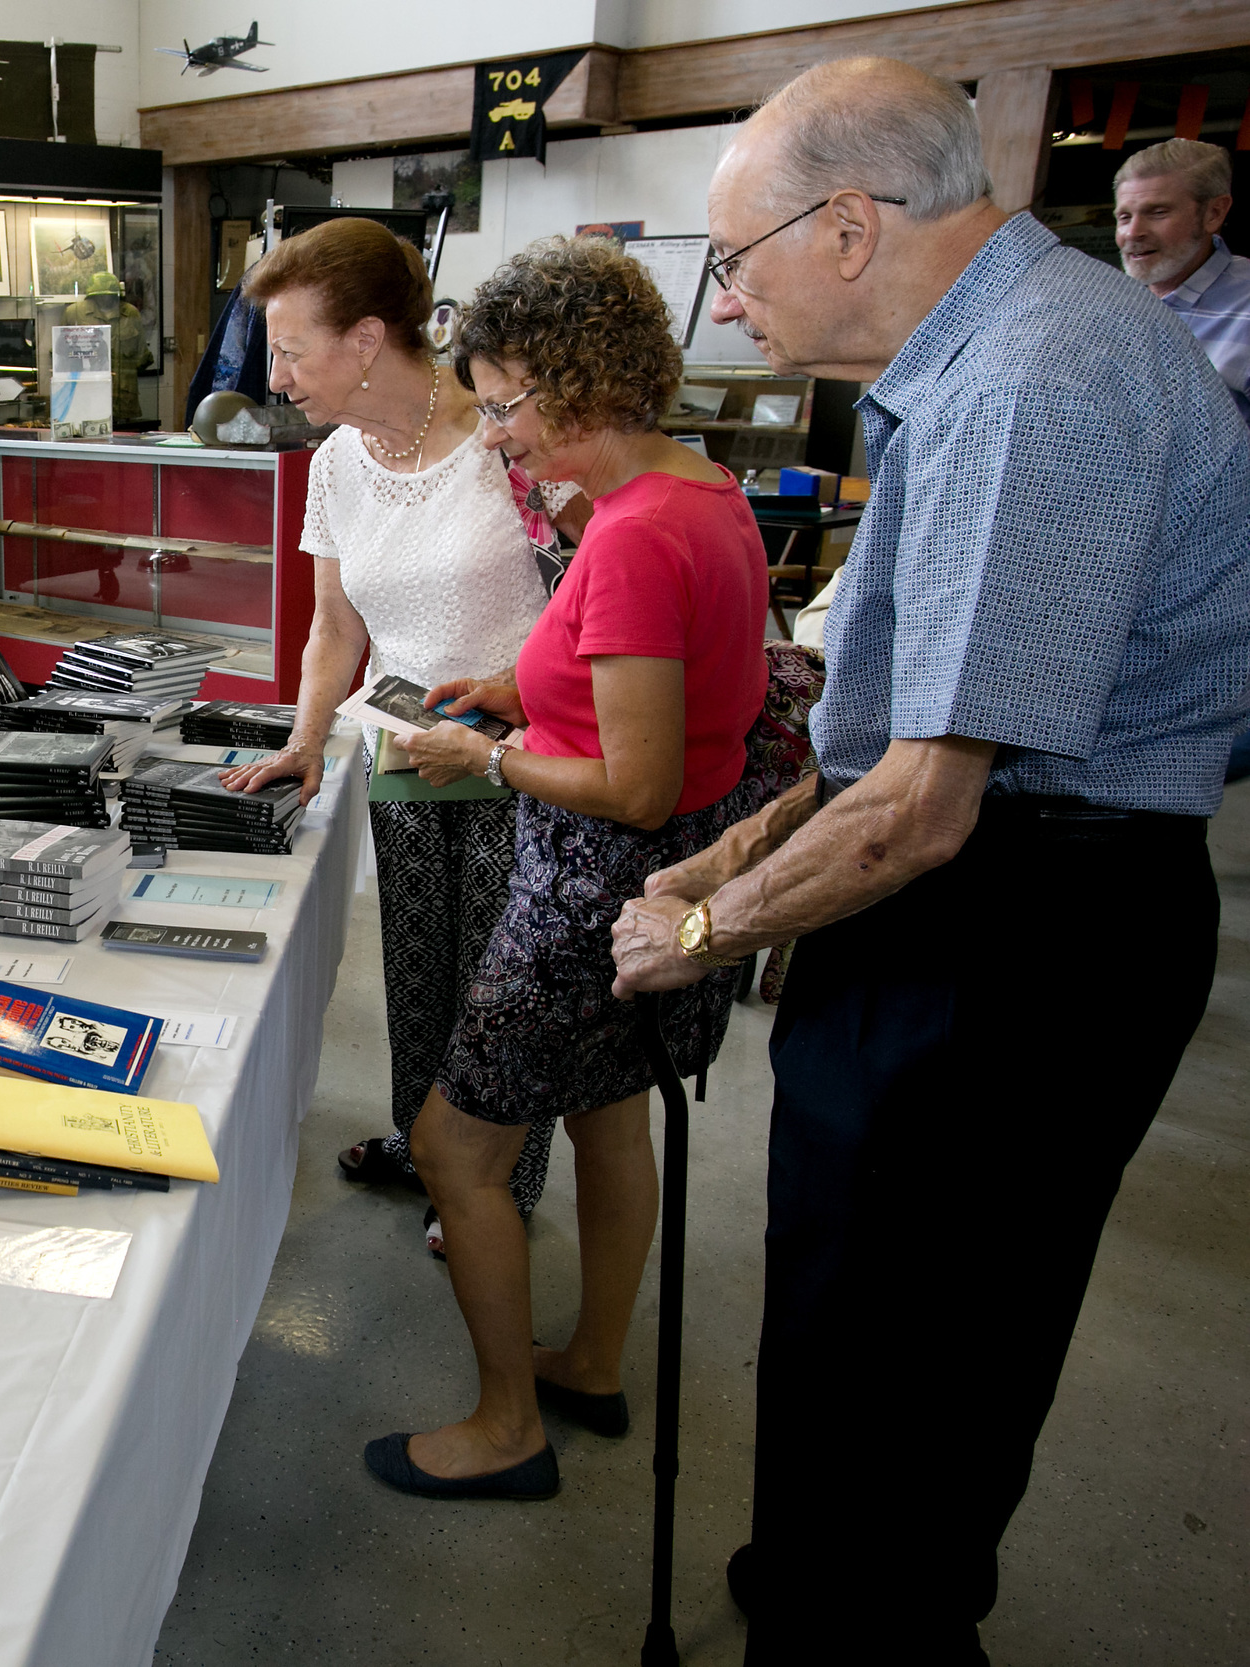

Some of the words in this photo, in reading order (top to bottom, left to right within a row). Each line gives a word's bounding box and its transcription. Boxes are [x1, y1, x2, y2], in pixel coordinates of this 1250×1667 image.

[489, 67, 541, 91] 704
[499, 131, 515, 150] A
[28, 861, 36, 871] R.
[36, 863, 42, 873] J.
[42, 863, 67, 876] REILLY
[20, 874, 27, 884] R.
[27, 875, 33, 885] J.
[33, 875, 56, 888] REILLY
[18, 890, 25, 900] R.
[25, 891, 31, 901] J.
[31, 891, 54, 905] REILLY
[17, 907, 24, 916] R.
[24, 907, 31, 918] J.
[30, 907, 54, 920] REILLY
[22, 924, 29, 934] R.
[30, 925, 36, 934] J.
[36, 924, 61, 937] REILLY
[119, 1102, 143, 1155] CHRISTIANITY
[137, 1106, 161, 1150] LITERATURE
[21, 1181, 50, 1191] REVIEW
